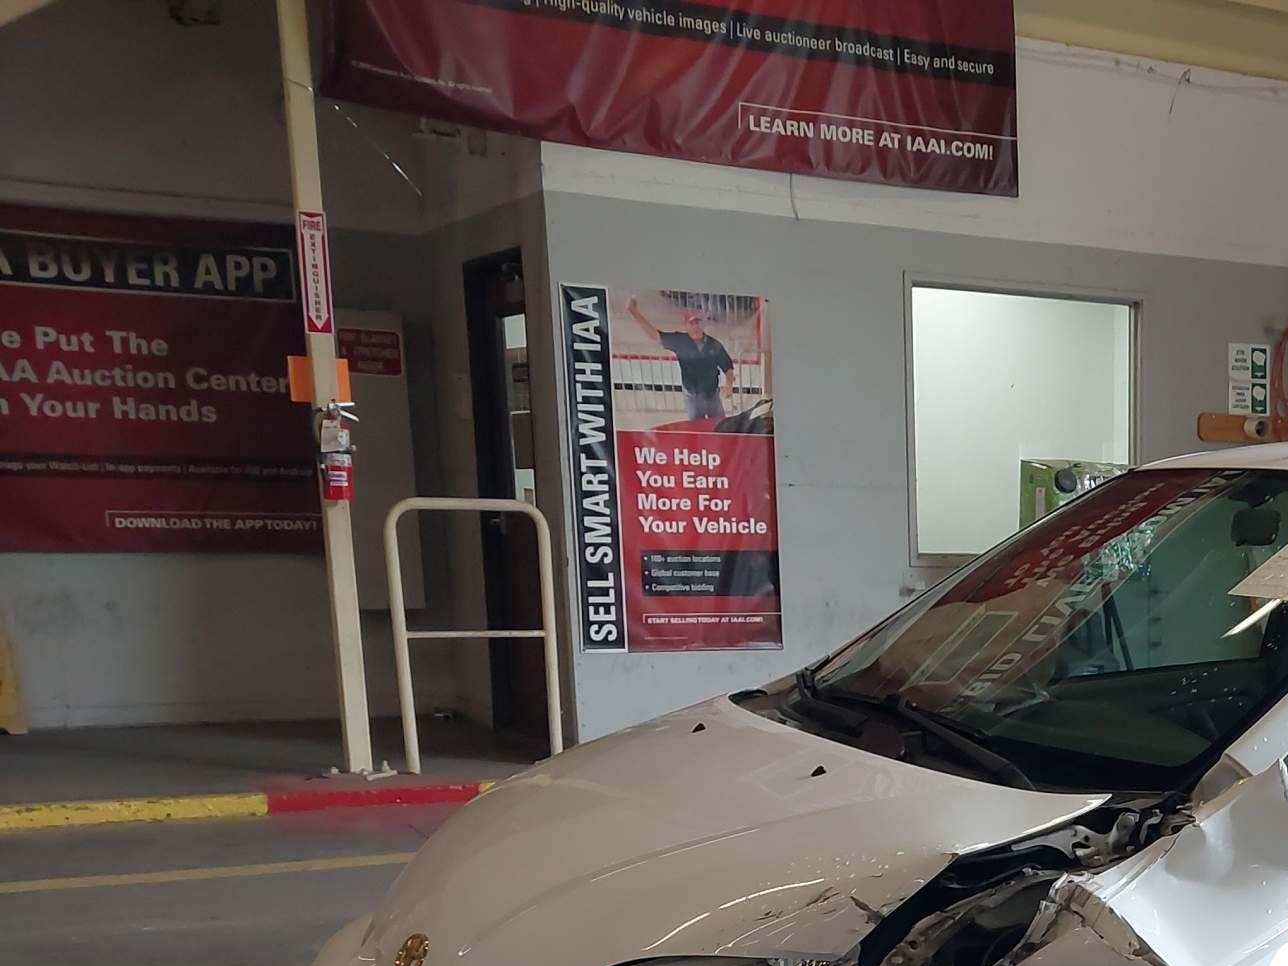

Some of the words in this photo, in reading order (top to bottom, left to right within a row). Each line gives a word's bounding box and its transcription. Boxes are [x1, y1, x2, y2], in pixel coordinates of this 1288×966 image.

[628, 8, 675, 26] vehicle
[679, 13, 727, 34] images
[737, 22, 760, 40] Live
[765, 29, 831, 51] auctioneer
[835, 40, 894, 61] broadcast
[904, 49, 930, 70] Easy
[933, 55, 955, 69] and
[957, 60, 994, 75] secure
[749, 115, 813, 138] LEARN
[820, 124, 874, 146] MORE
[879, 133, 902, 149] AT
[907, 136, 994, 161] IAAI.COM!
[302, 220, 321, 231] FIRE
[27, 244, 181, 288] BUYER
[194, 253, 278, 293] APP
[570, 295, 599, 353] IAA
[0, 330, 21, 349] e
[34, 326, 95, 353] Put
[105, 330, 169, 356] The
[46, 361, 176, 389] Auction
[185, 367, 288, 393] Center
[19, 393, 101, 419] Your
[112, 396, 218, 422] Hands
[575, 364, 606, 445] WITH
[635, 447, 667, 465] We
[674, 449, 721, 470] Help
[636, 470, 676, 488] You
[682, 472, 729, 488] Earn
[580, 454, 613, 564] SMART
[637, 494, 692, 511] More
[699, 495, 731, 511] For
[114, 517, 202, 529] DOWNLOAD
[203, 518, 231, 529] THE
[234, 519, 263, 530] APP
[266, 519, 316, 530] TODAY!
[638, 516, 687, 533] Your
[692, 517, 768, 534] Vehicle
[588, 571, 617, 641] SELL
[698, 616, 719, 624] TODAY
